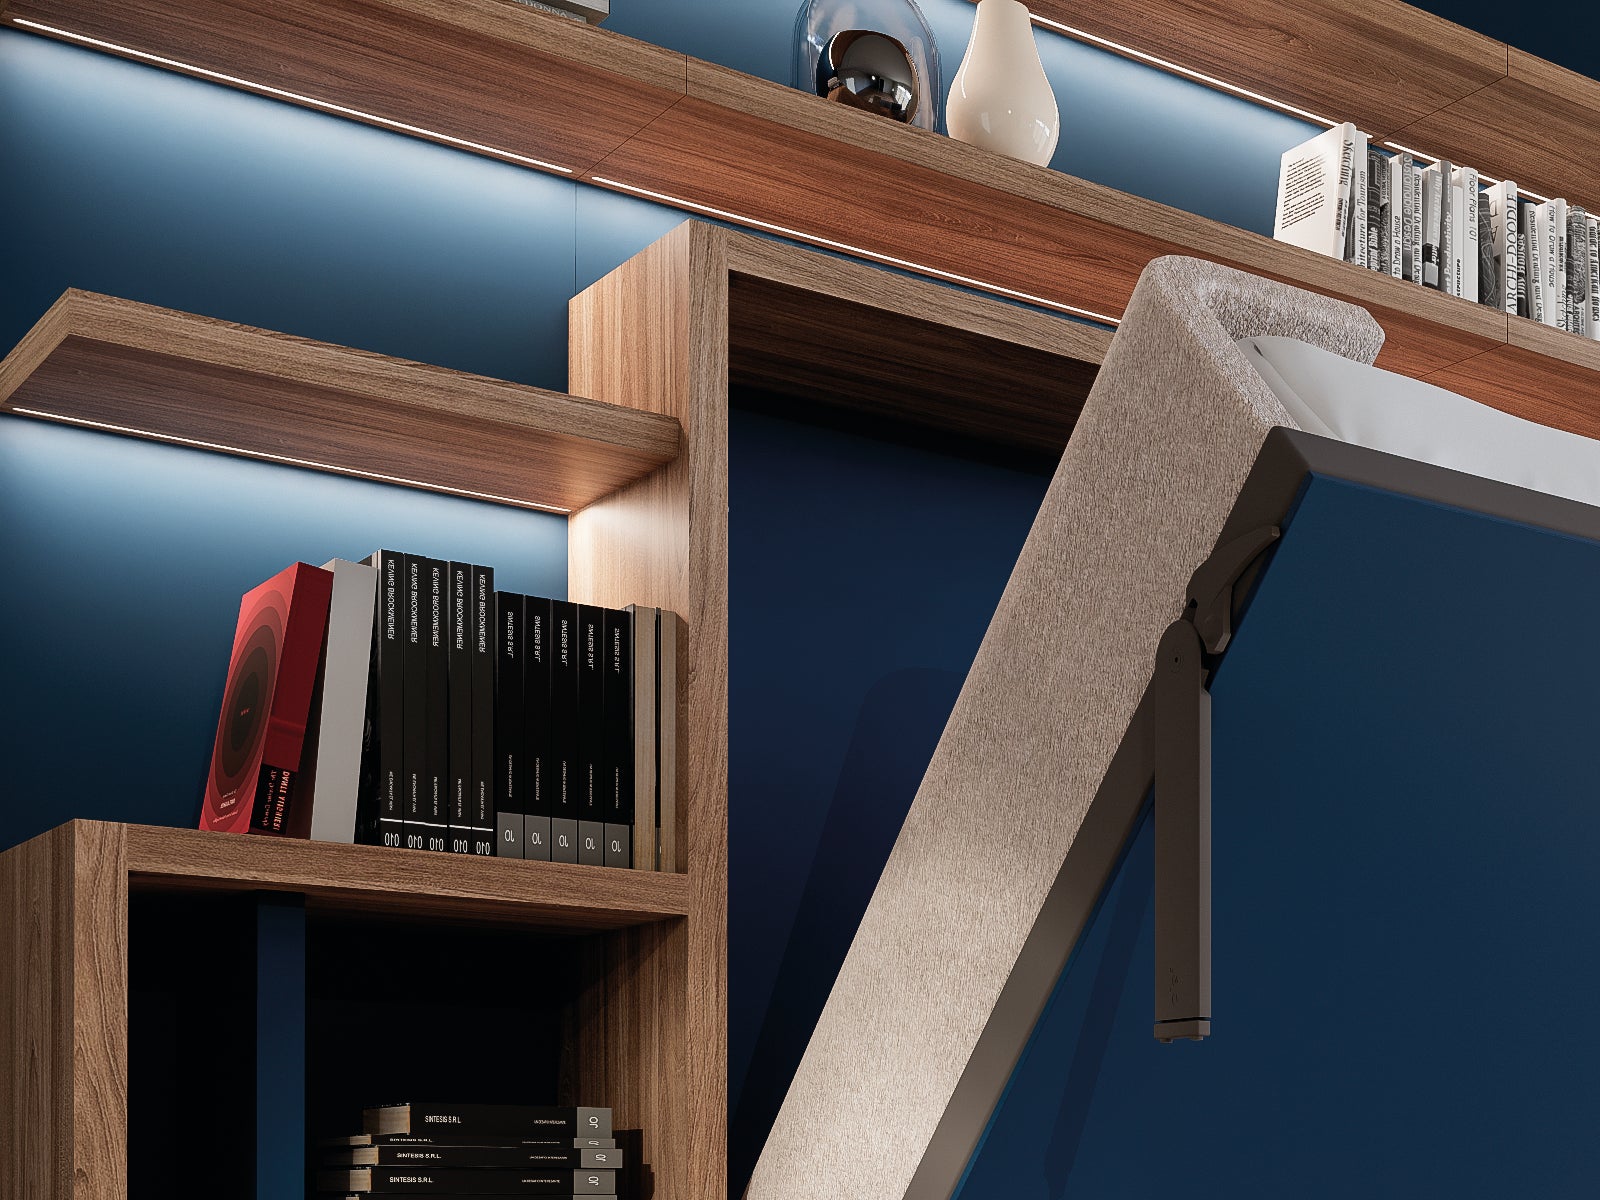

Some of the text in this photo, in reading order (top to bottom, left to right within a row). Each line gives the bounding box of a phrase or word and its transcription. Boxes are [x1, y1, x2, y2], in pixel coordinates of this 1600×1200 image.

[1357, 171, 1366, 207] Tourism
[1402, 157, 1412, 251] Sustainable Design
[1468, 173, 1477, 241] Floor Plans 101
[1392, 216, 1401, 238] House
[1507, 194, 1517, 312] ARCHI-DOODLE
[1548, 264, 1556, 288] House
